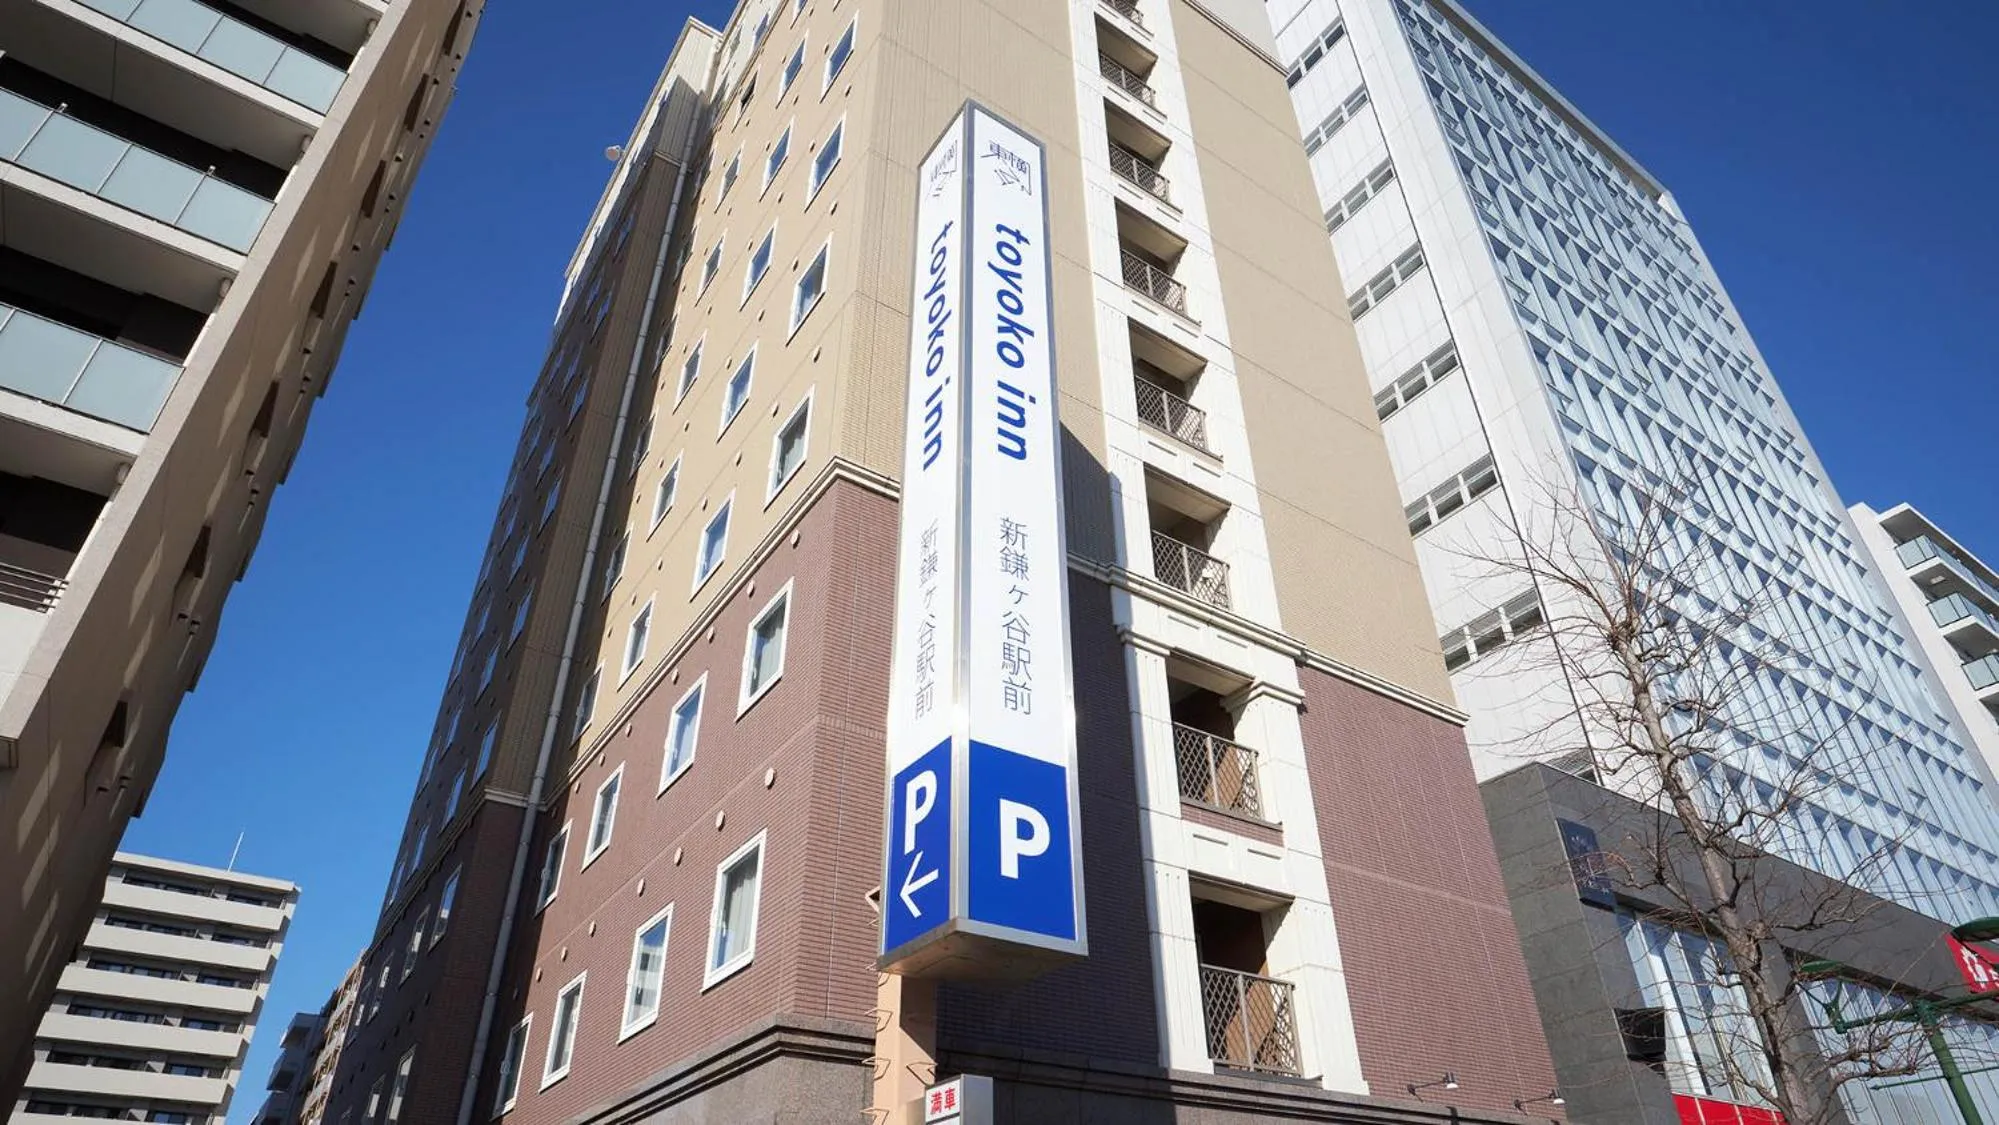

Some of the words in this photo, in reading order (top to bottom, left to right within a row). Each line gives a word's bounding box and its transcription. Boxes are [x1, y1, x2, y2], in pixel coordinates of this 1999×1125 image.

[924, 220, 953, 377] toyoko
[988, 223, 1035, 369] toyoko
[923, 378, 951, 471] inn
[997, 381, 1036, 461] inn
[904, 769, 938, 855] P
[1000, 798, 1051, 879] P
[930, 1087, 956, 1114] 満車
